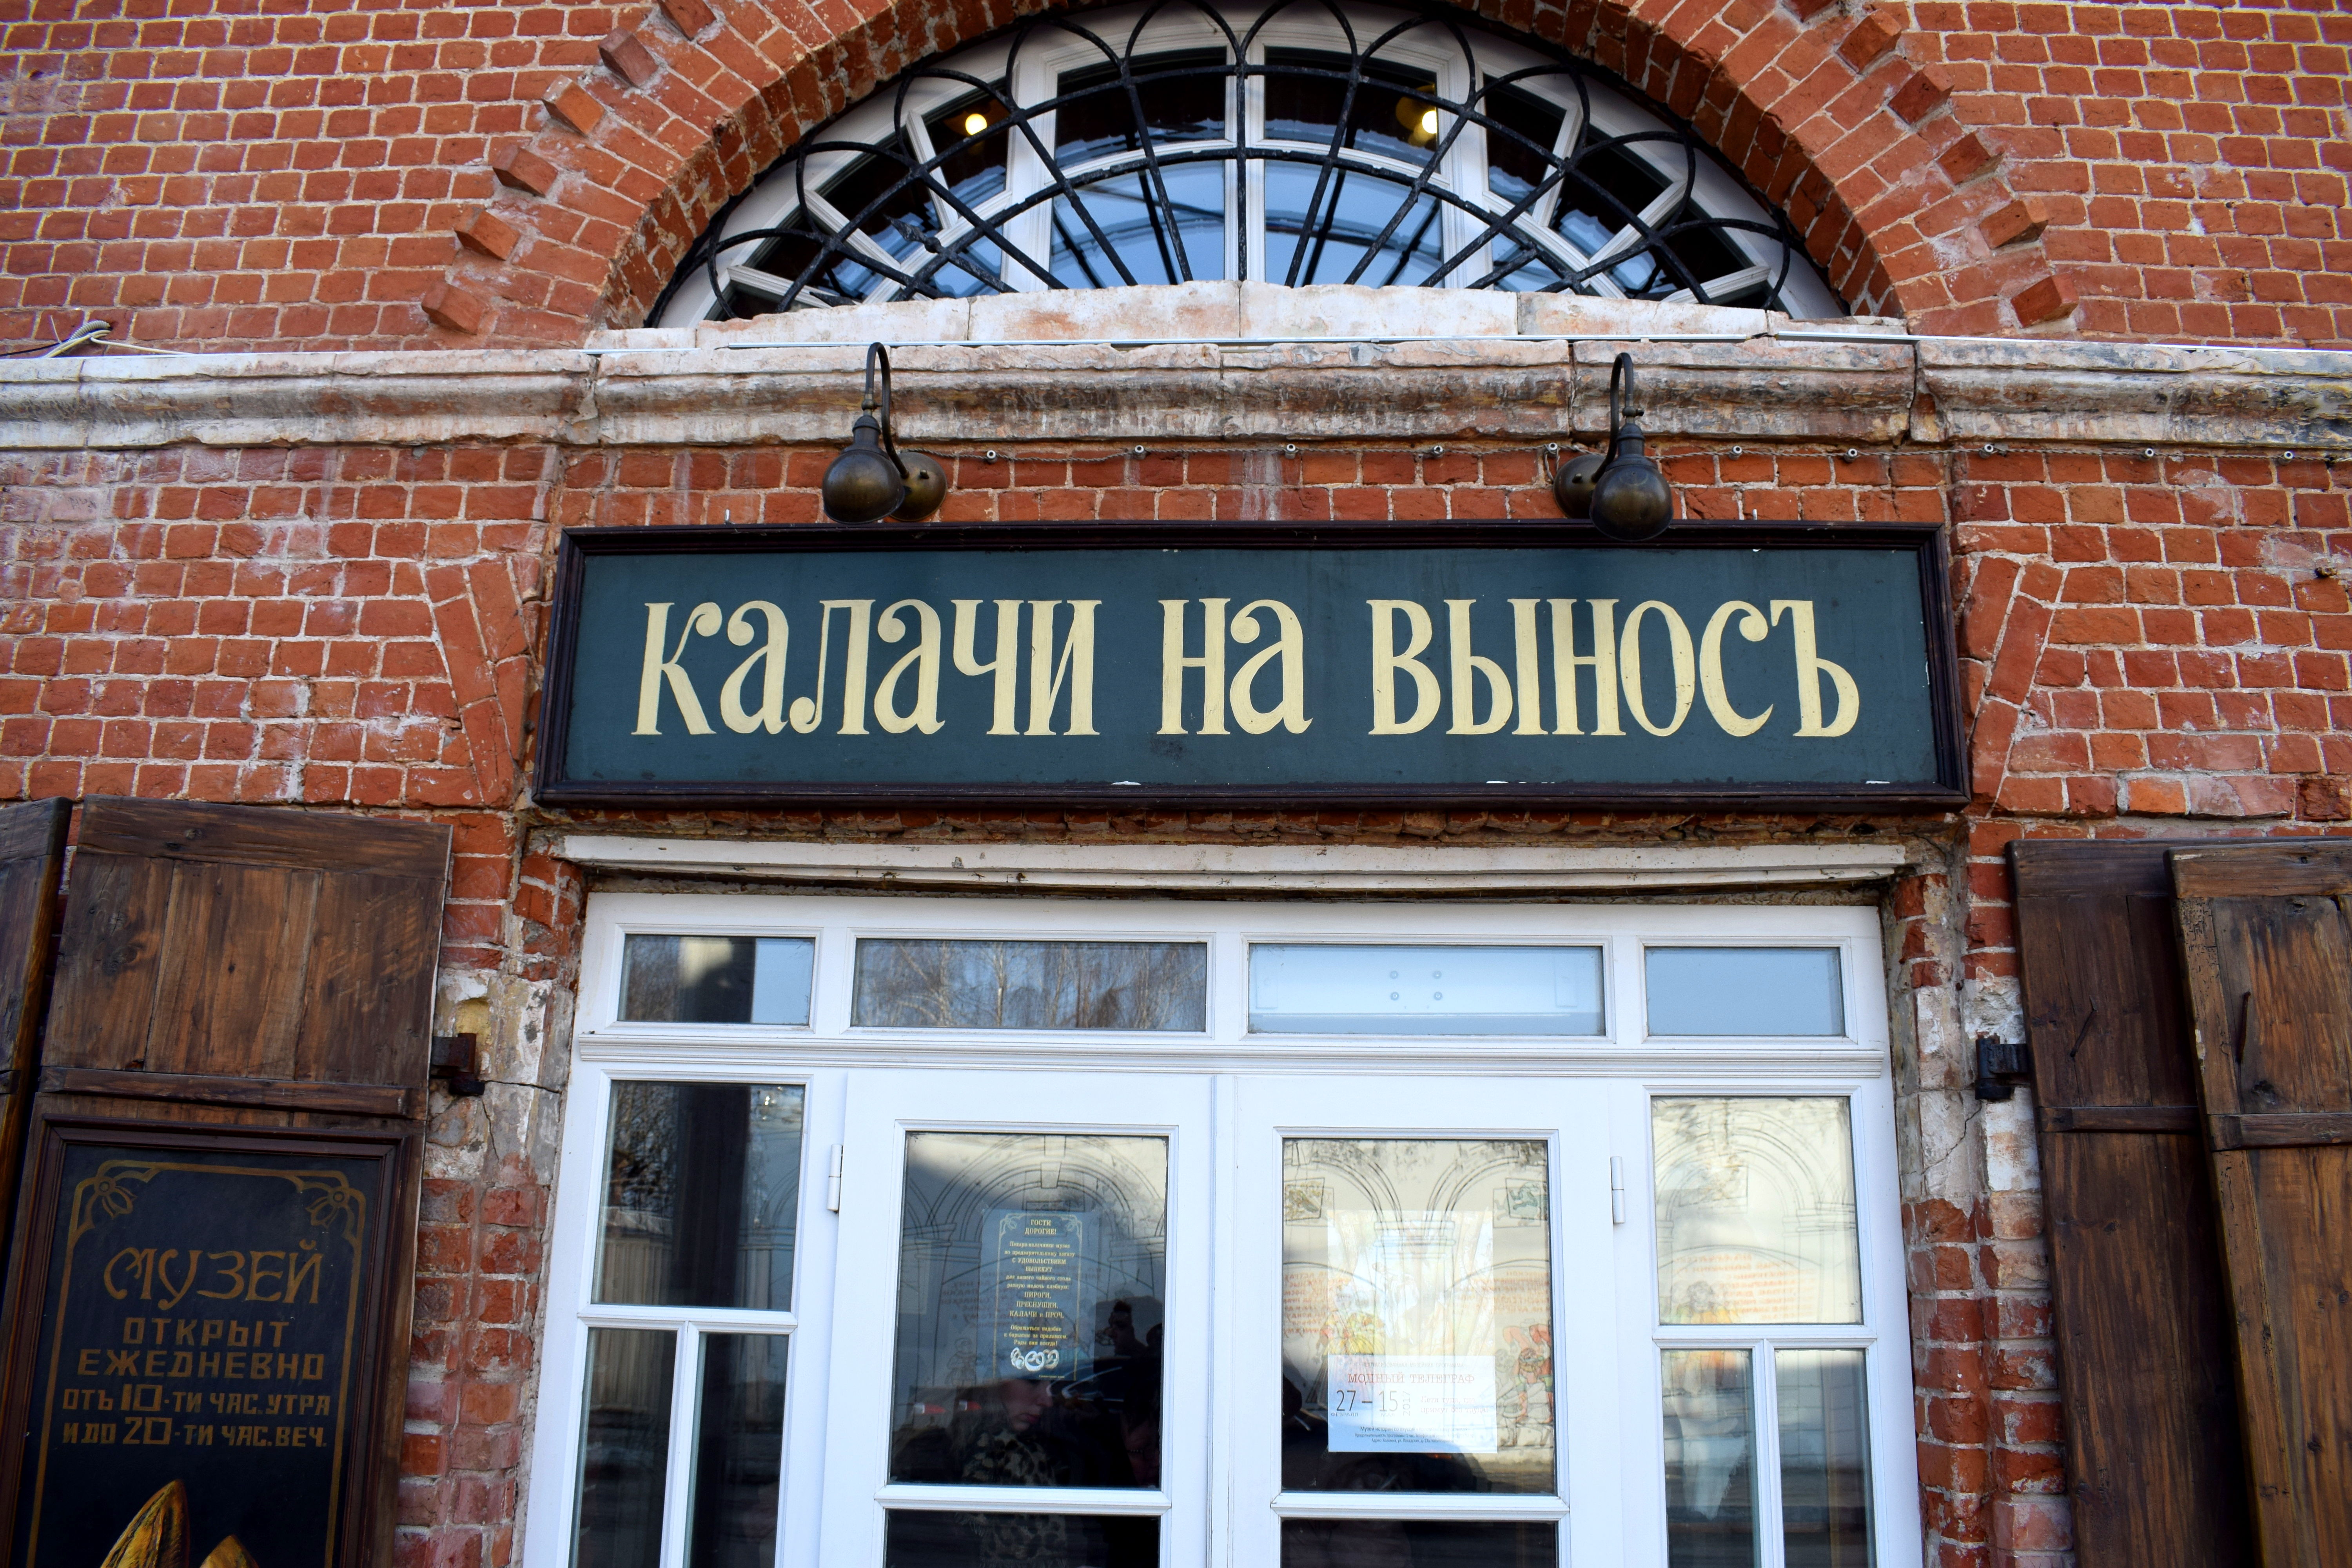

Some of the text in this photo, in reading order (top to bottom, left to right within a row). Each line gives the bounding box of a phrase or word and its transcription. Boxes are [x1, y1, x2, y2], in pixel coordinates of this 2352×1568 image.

[1367, 599, 1859, 737] ВЫНОСЪ
[104, 1239, 324, 1310] МУЗЕЙ
[123, 1318, 289, 1347] ОТКРЫТ
[78, 1349, 324, 1380] ЕЖЕДНЕВНО
[1348, 1372, 1474, 1385] МОДНЫЙ ТЕЛЕГРАФ
[63, 1389, 113, 1410] ОТЪ
[1336, 1390, 1356, 1412] 27
[1379, 1390, 1398, 1412] 15
